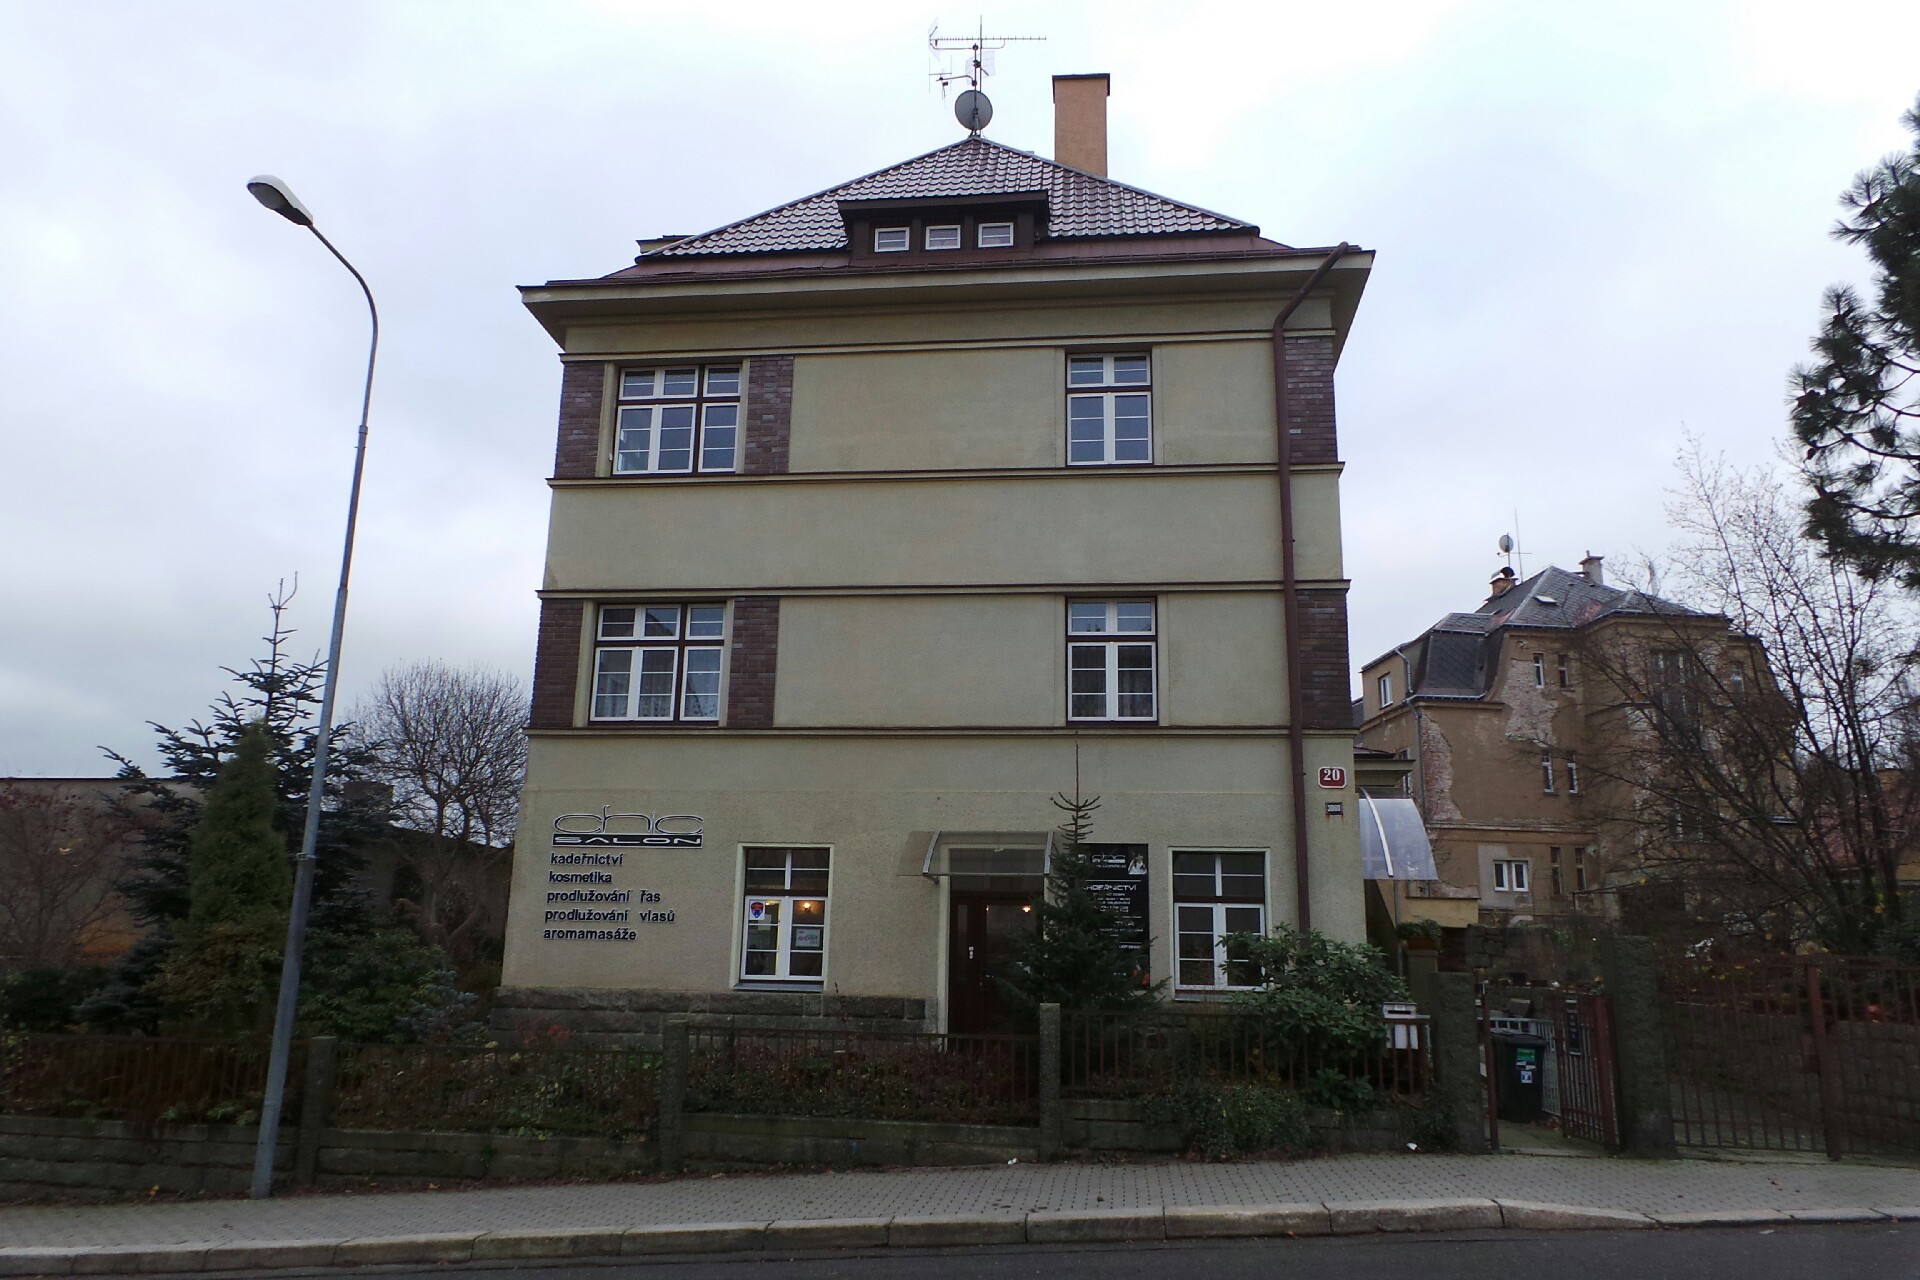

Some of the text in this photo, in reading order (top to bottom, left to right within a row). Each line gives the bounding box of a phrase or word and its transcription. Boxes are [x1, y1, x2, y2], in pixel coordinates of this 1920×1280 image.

[1323, 768, 1341, 781] 20
[550, 852, 624, 867] kadeřnictví
[549, 870, 613, 884] kosmetika
[546, 889, 661, 904] prodlužování řas
[544, 908, 675, 923] prodlužování vlasů
[543, 927, 637, 941] aromamasáže
